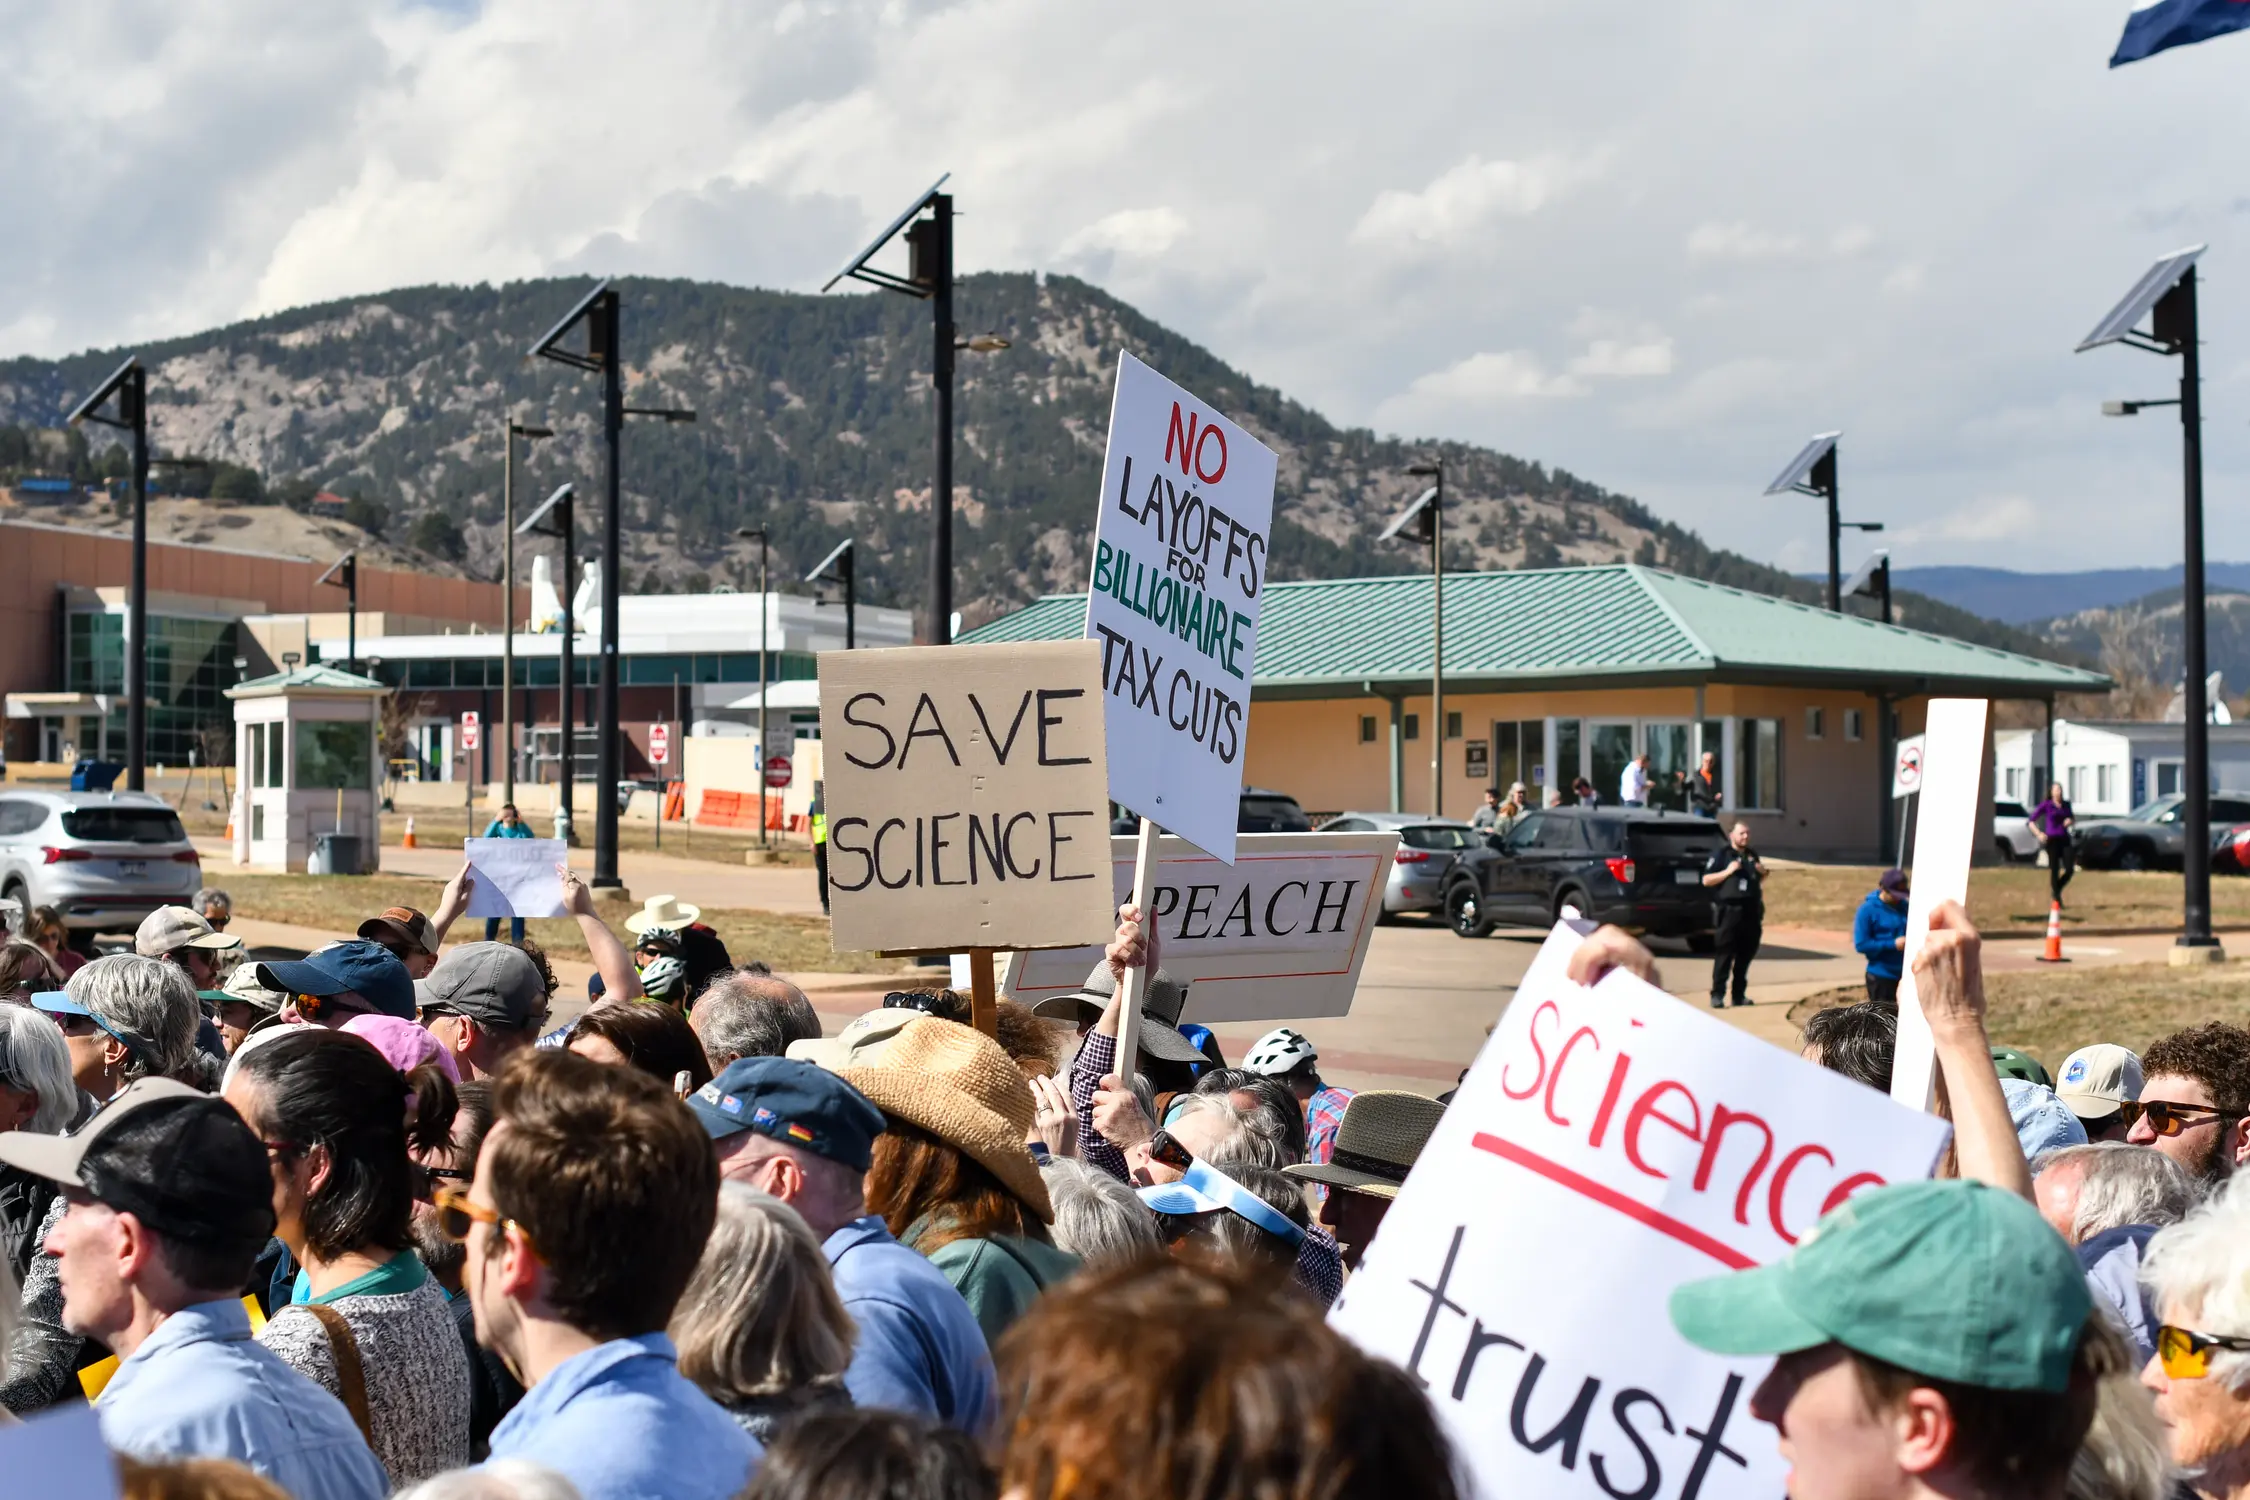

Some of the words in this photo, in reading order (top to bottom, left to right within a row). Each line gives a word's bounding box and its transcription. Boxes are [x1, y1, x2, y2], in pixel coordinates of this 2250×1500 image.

[1164, 401, 1227, 484] NO
[1119, 456, 1265, 598] LAYOFFS
[1166, 548, 1206, 591] FOR
[1093, 538, 1251, 681] BILLIONAIRE
[843, 689, 1092, 770] SAVE
[1096, 622, 1163, 717] TAX
[1168, 668, 1242, 764] CUTS
[829, 811, 1095, 891] SCIENCE
[1408, 1225, 1747, 1500] trust
